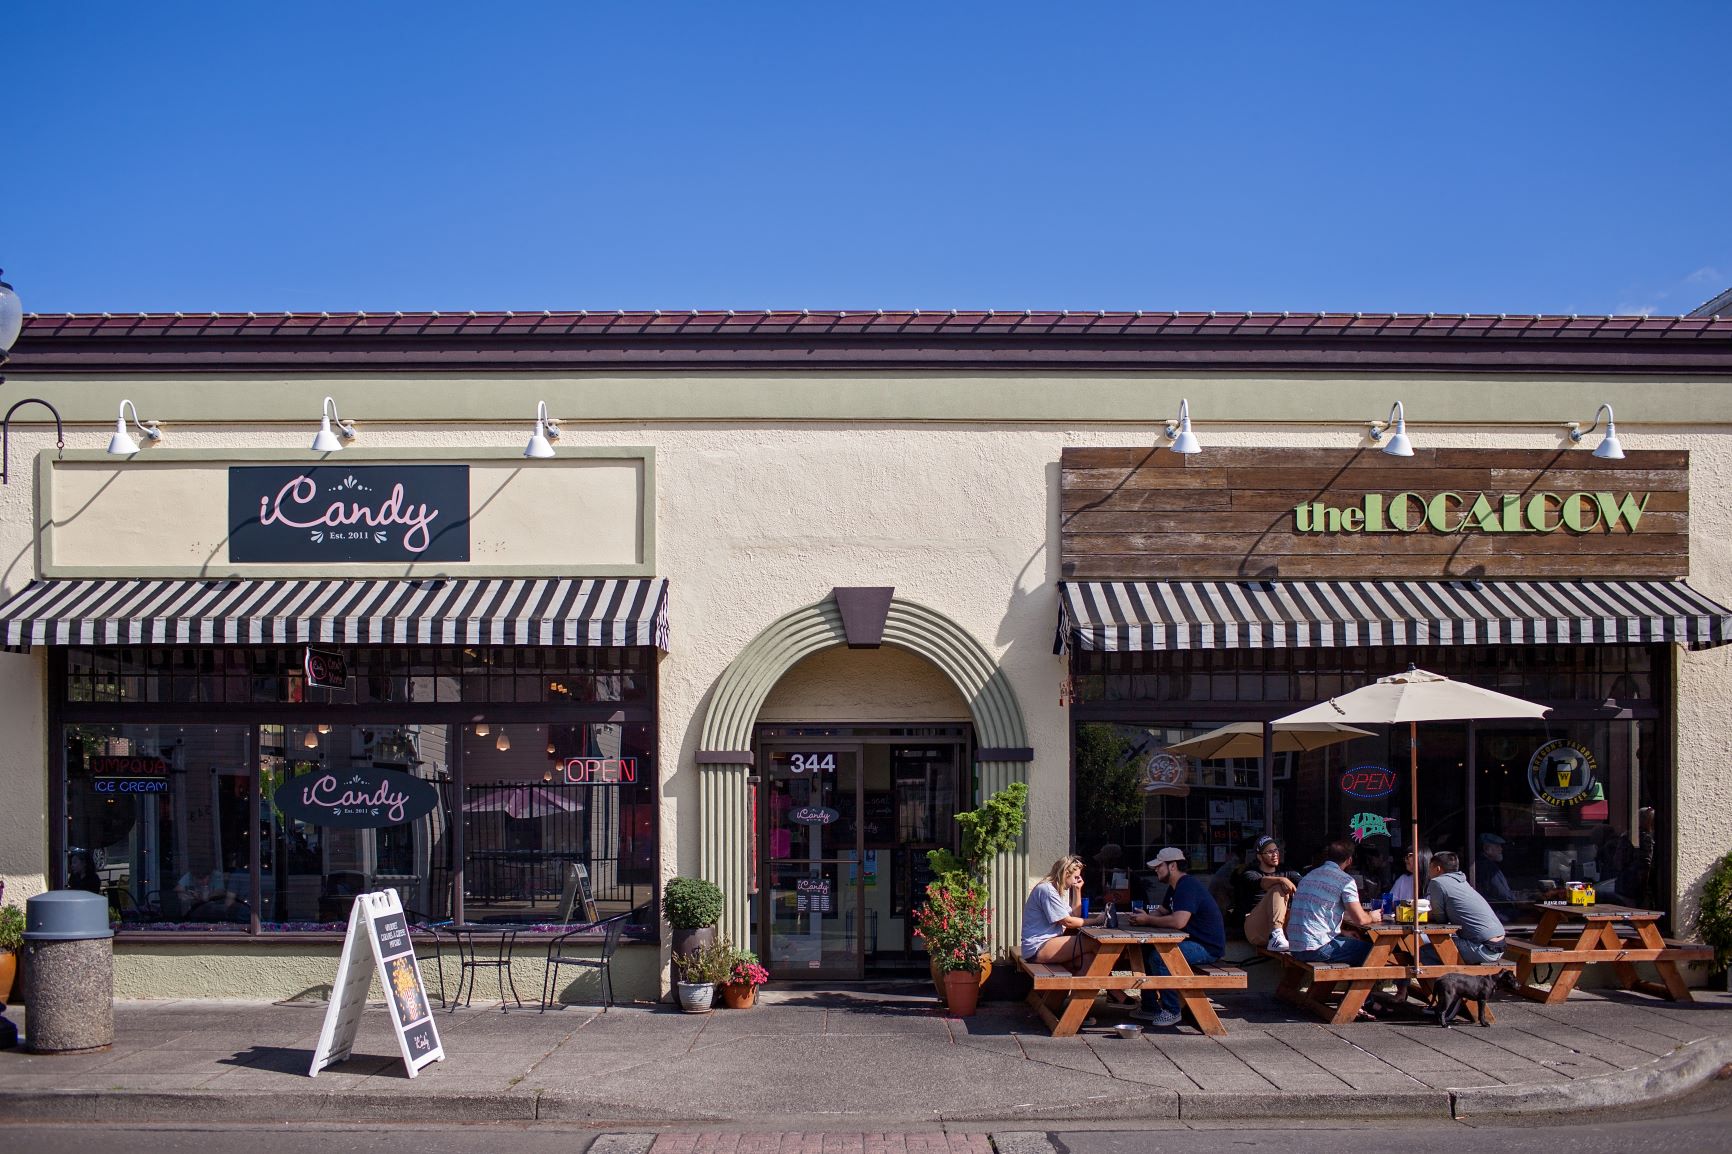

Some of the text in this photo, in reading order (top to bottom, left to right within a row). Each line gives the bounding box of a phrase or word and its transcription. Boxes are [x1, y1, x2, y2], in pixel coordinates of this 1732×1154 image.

[260, 474, 439, 553] iCandy
[329, 531, 369, 540] Est. 2011
[790, 753, 836, 773] 344
[1567, 740, 1598, 769] FAVORITE
[94, 757, 167, 774] UMPQUA
[567, 759, 635, 782] OPEN
[94, 781, 168, 792] ICE CREAM
[1341, 772, 1397, 791] OPEN
[303, 774, 410, 821] iCandy
[1541, 792, 1565, 807] CRAFT
[1569, 791, 1588, 806] BEER
[796, 808, 831, 824] iCandy
[797, 880, 830, 894] iCandy
